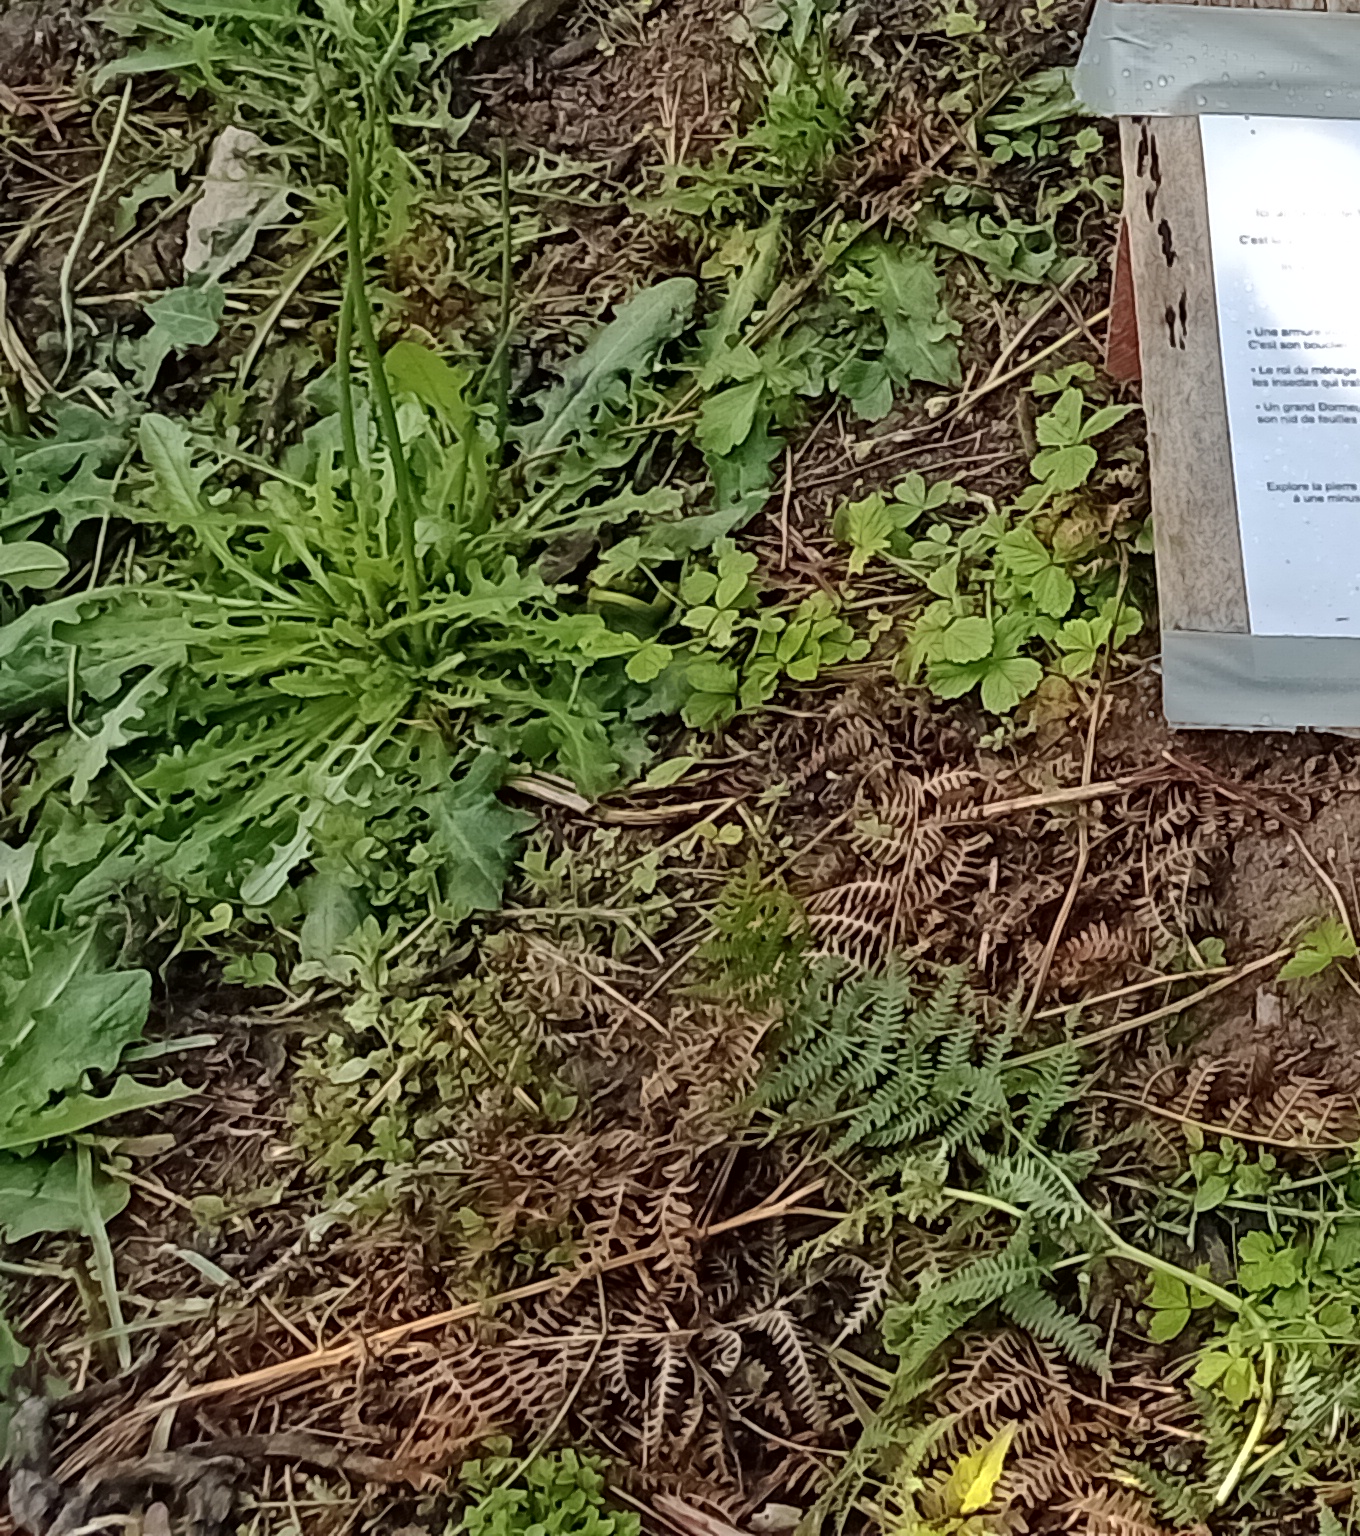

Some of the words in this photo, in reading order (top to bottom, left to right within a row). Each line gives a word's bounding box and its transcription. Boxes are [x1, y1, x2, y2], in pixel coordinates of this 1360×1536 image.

[1280, 342, 1301, 350] son
[1258, 366, 1274, 375] Le
[1276, 366, 1292, 375] roi
[1294, 366, 1309, 375] du
[1252, 378, 1269, 387] les
[1272, 378, 1319, 387] insectes
[1321, 378, 1338, 389] qui
[1263, 403, 1280, 412] Un
[1283, 402, 1315, 413] grand
[1257, 415, 1278, 424] son
[1301, 415, 1315, 424] de
[1267, 482, 1309, 492] Explore
[1326, 482, 1357, 492] pierre
[1293, 494, 1300, 503] à
[1304, 495, 1324, 503] une
